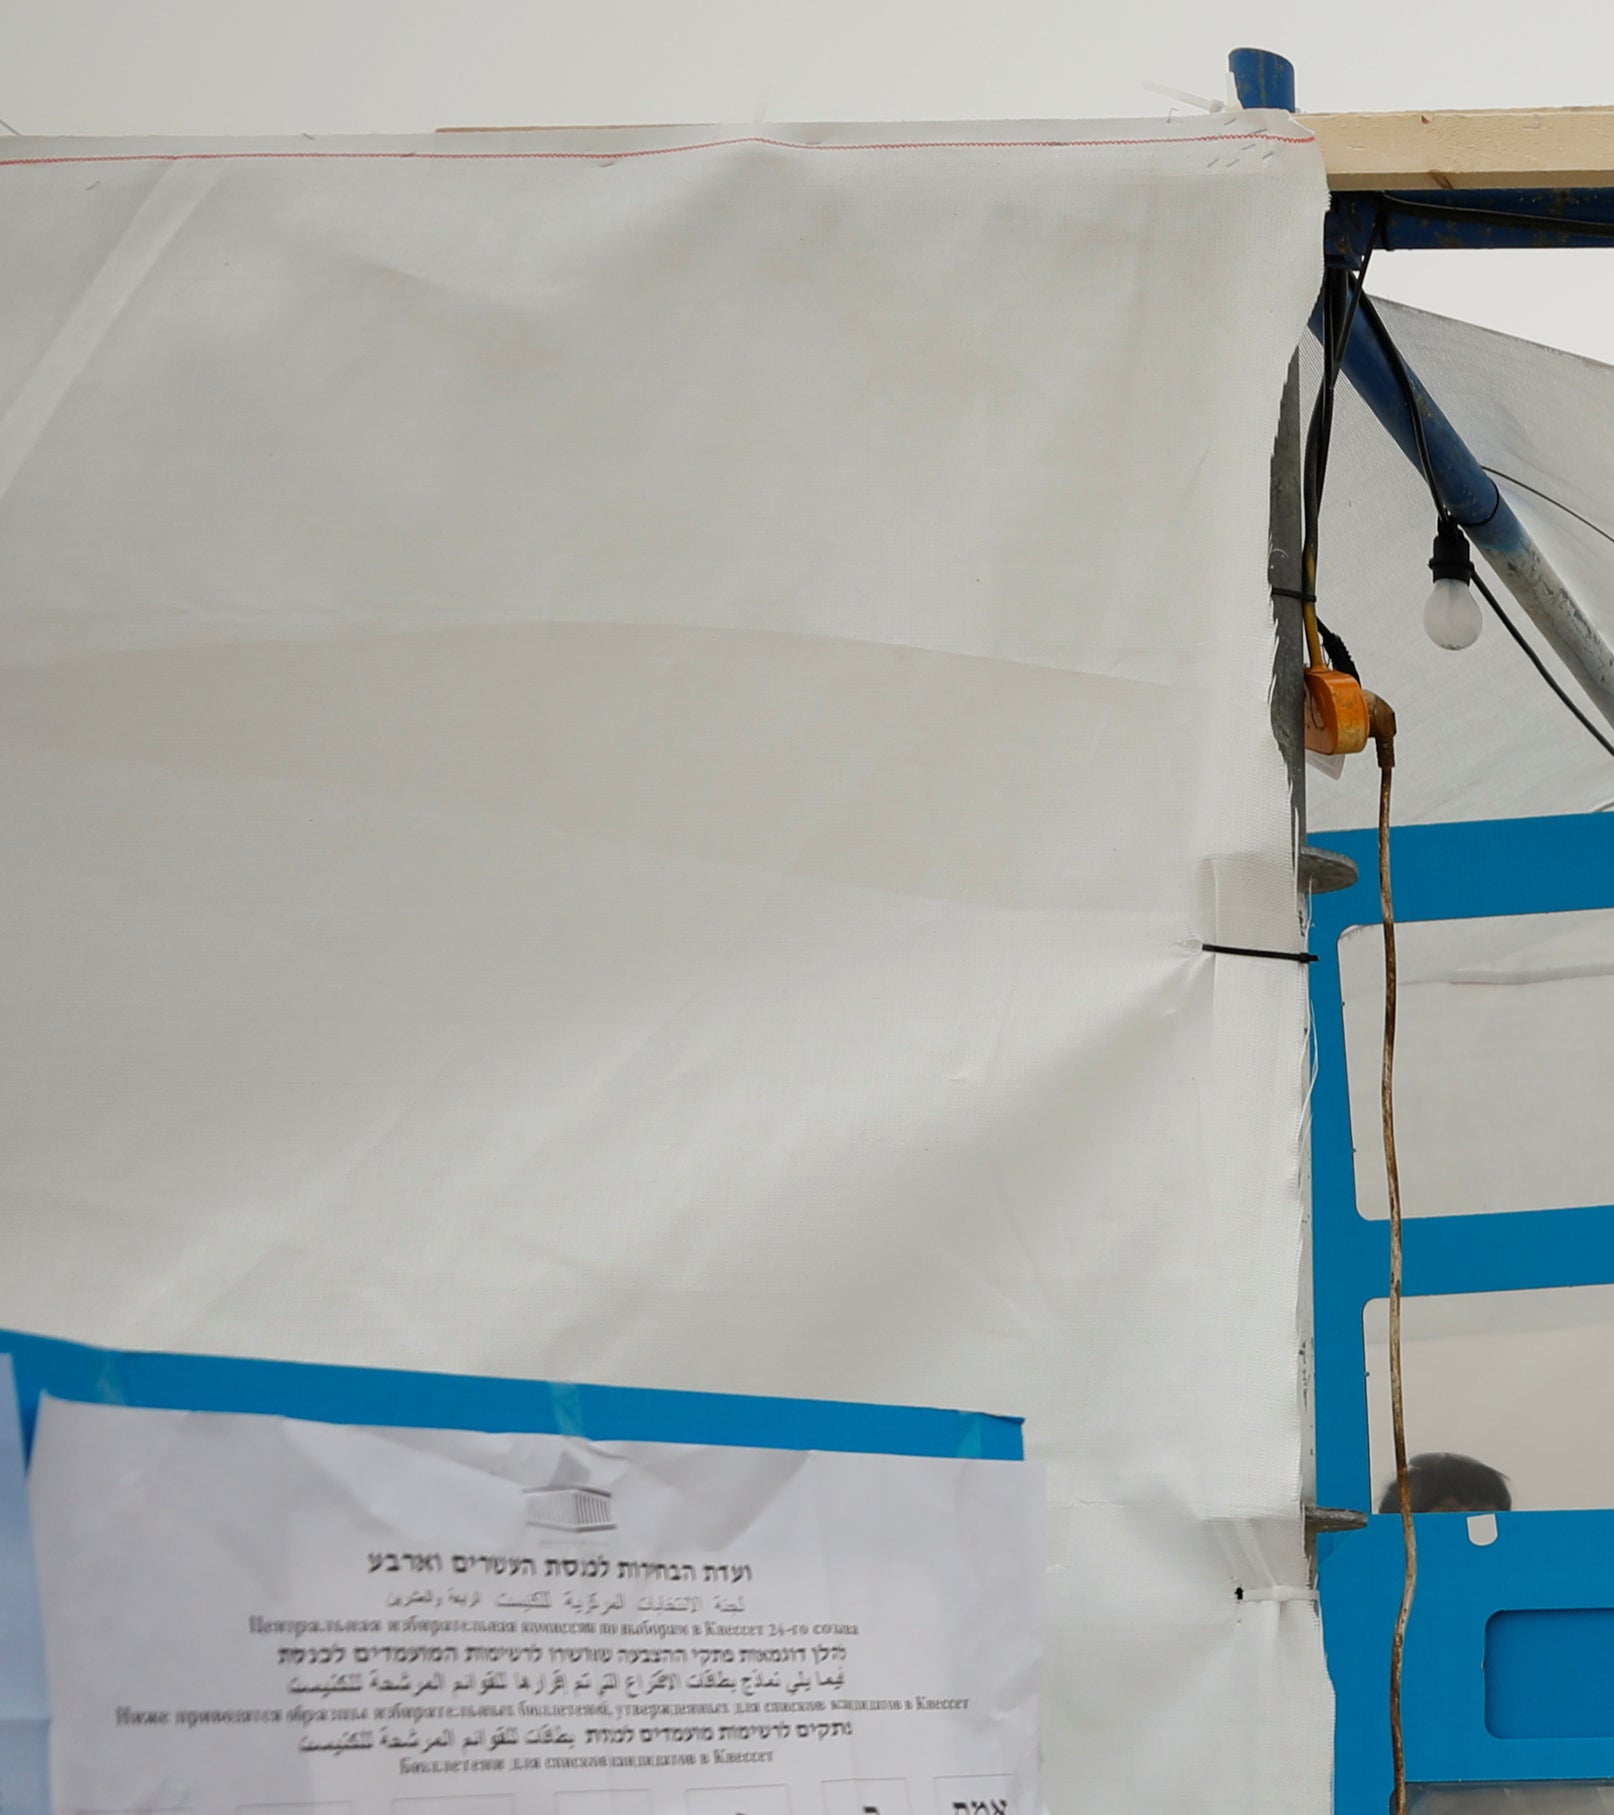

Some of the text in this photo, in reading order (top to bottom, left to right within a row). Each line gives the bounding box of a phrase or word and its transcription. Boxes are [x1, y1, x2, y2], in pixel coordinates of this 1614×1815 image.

[368, 1553, 752, 1584] ועדת הבחירות לכנסת העשרים וארבע
[704, 1621, 765, 1637] Кнессет
[278, 1643, 346, 1665] לכנסת
[353, 1645, 458, 1664] המועמדים
[464, 1643, 542, 1664] לרשימות
[618, 1648, 687, 1664] ההצבעה
[691, 1648, 733, 1668] פתקי
[914, 1695, 970, 1711] Кнессет
[641, 1726, 713, 1744] מועמדים
[719, 1720, 790, 1741] לרשימות
[713, 1750, 774, 1769] Кнессет
